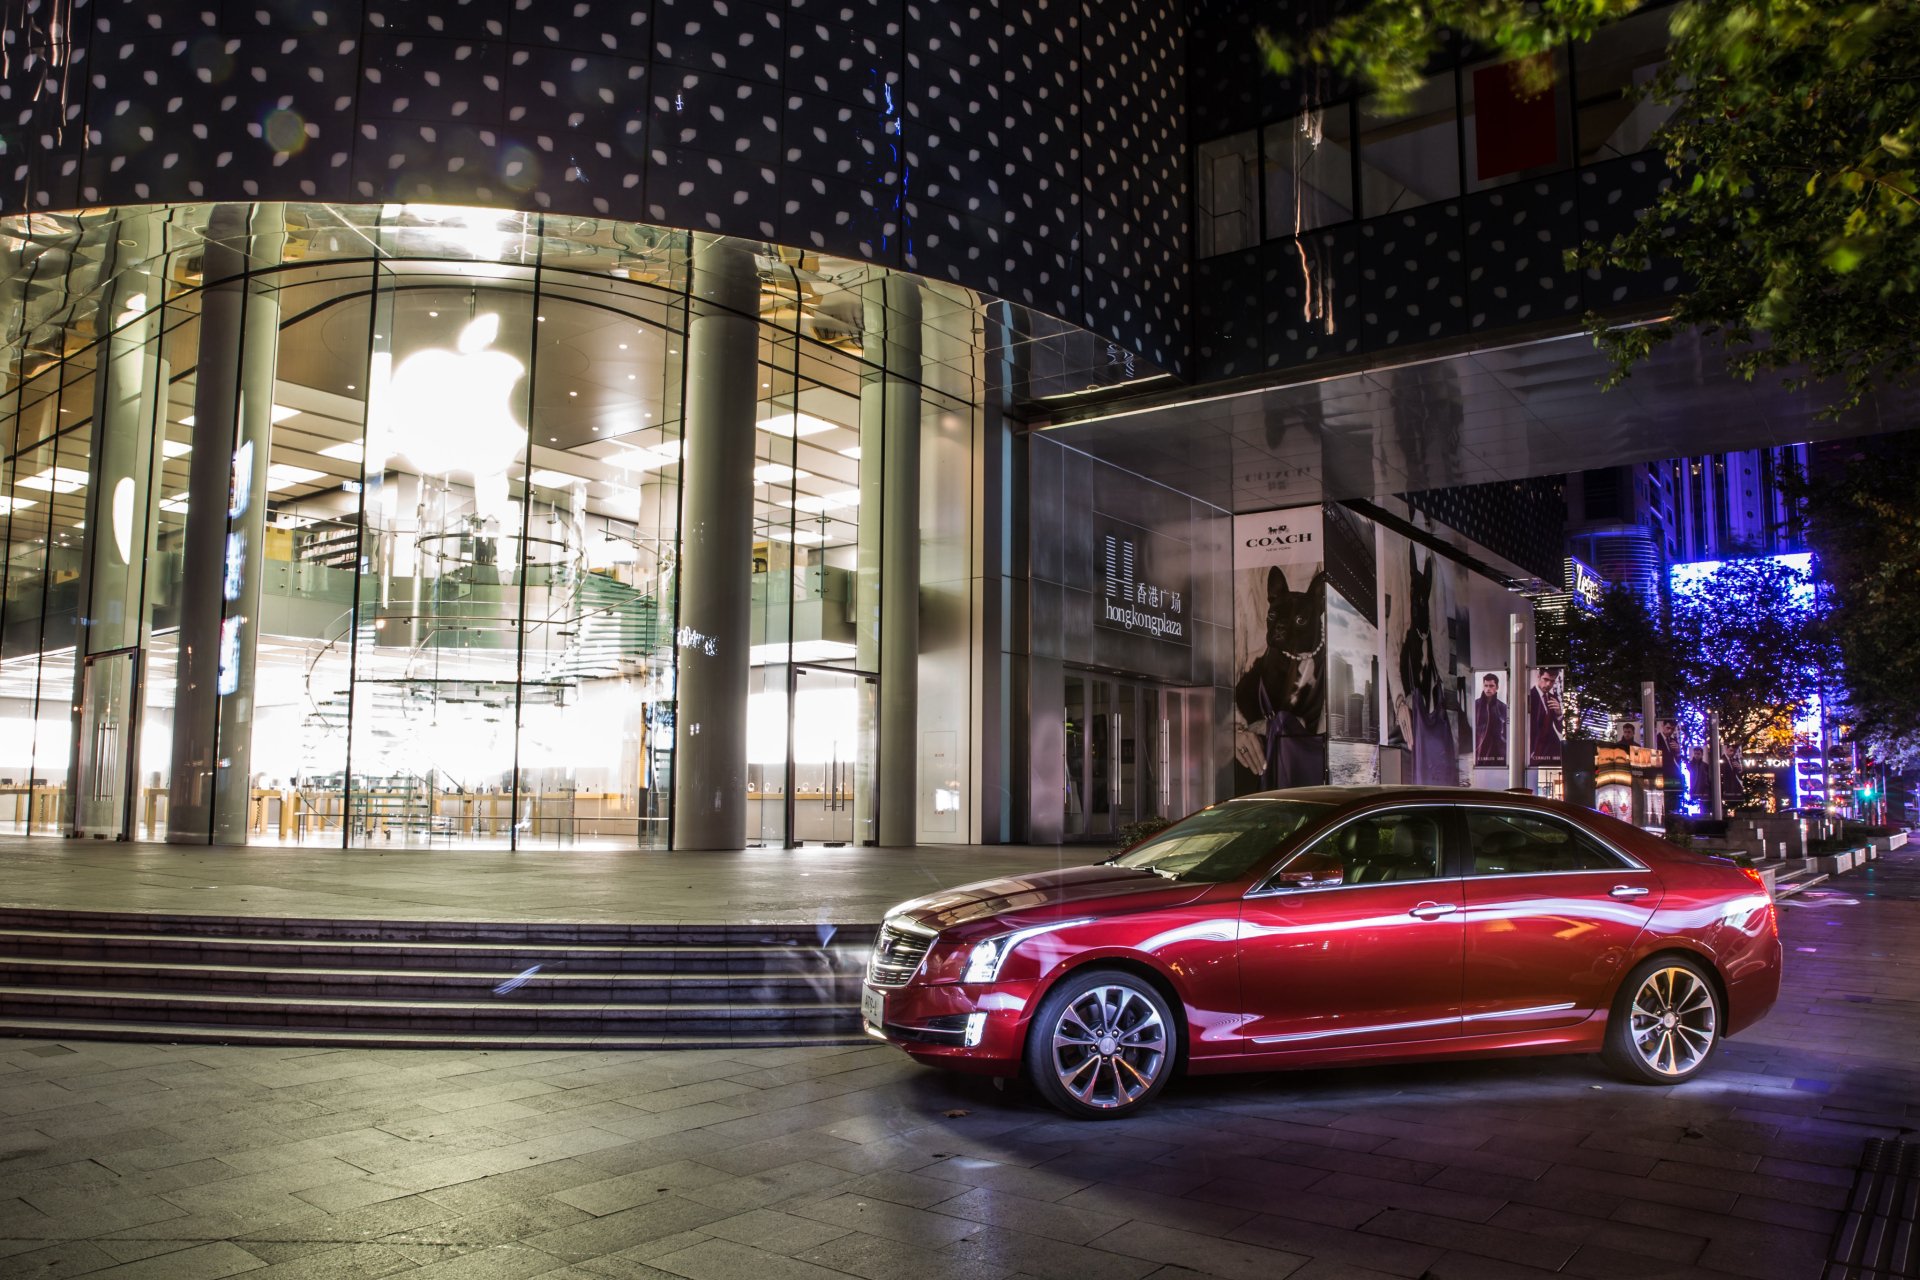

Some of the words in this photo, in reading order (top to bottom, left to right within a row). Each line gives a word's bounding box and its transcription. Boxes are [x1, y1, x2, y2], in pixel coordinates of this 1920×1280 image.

[1246, 533, 1312, 548] COACH
[1137, 582, 1181, 614] 香港广场
[1105, 597, 1182, 637] hongkongplaza
